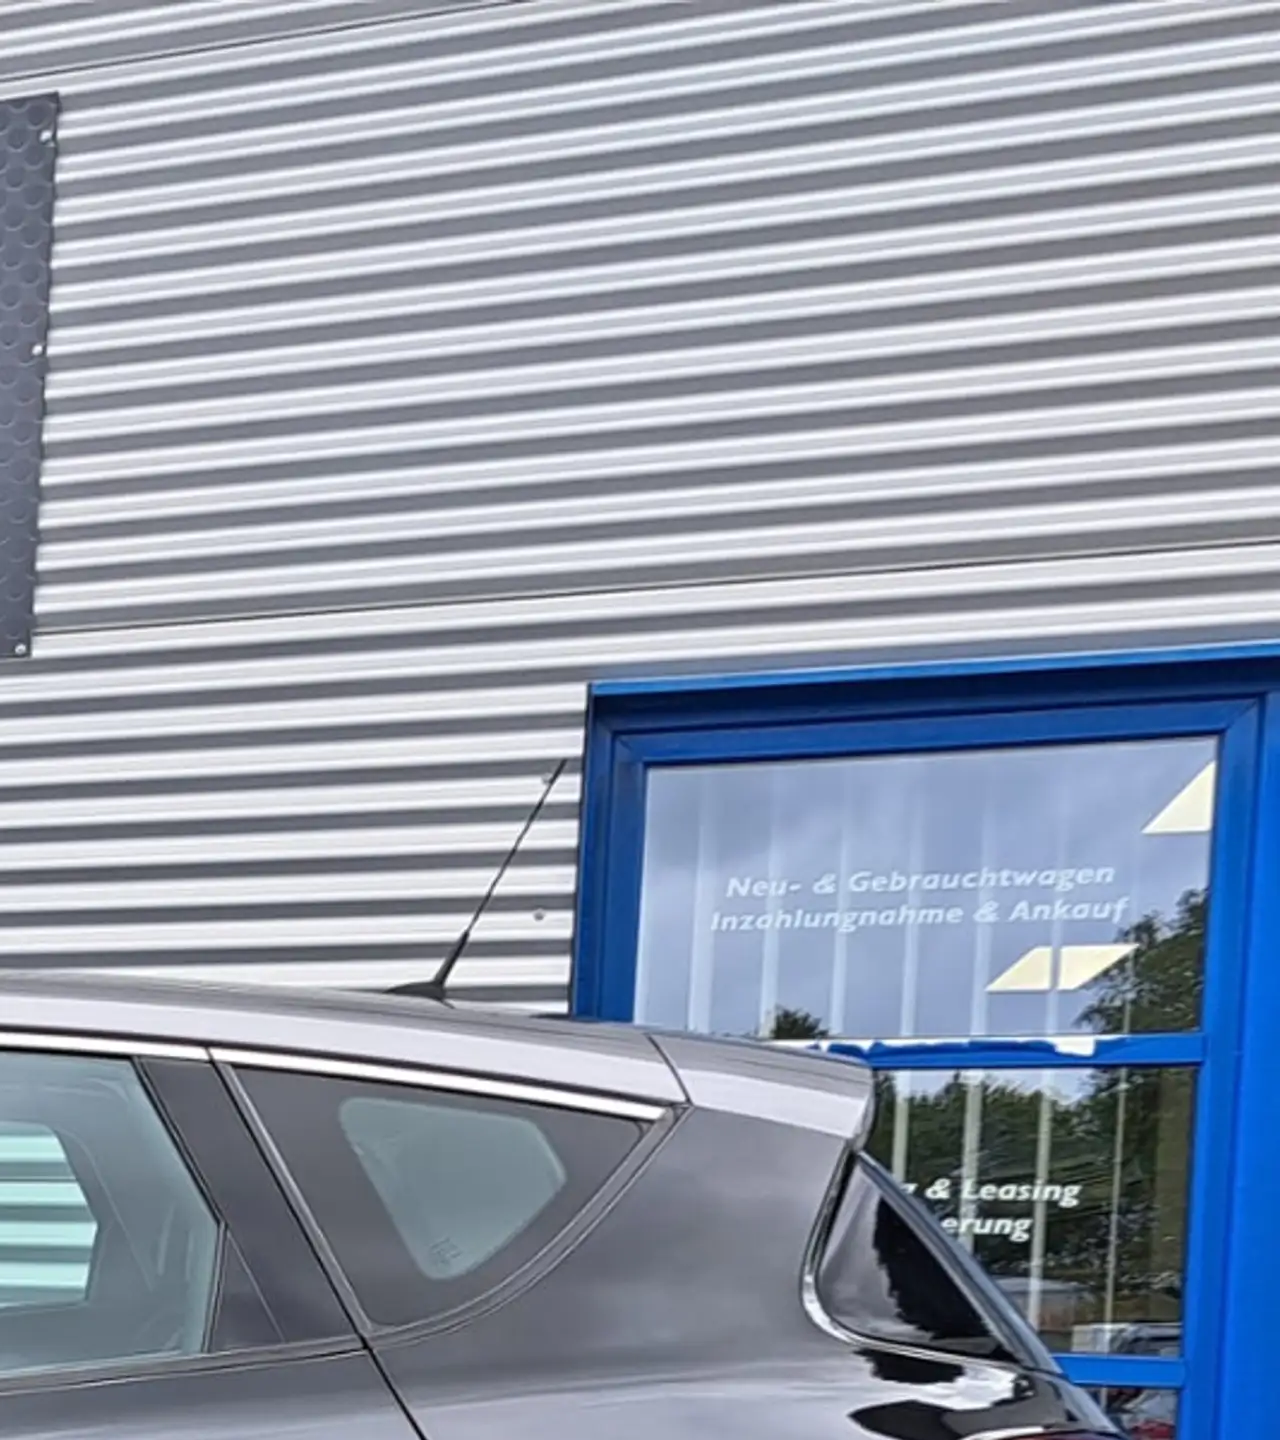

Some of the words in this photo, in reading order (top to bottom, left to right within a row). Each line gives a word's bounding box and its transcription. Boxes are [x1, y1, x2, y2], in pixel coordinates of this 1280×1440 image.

[726, 876, 802, 898] Neu-
[812, 873, 837, 895] &
[848, 866, 1115, 893] Gebrauchtwagen
[710, 904, 964, 933] Inzahlungnahme
[972, 899, 1000, 923] &
[1008, 896, 1129, 925] Ankauf
[925, 1178, 952, 1200] &
[961, 1178, 1083, 1208] Leasing
